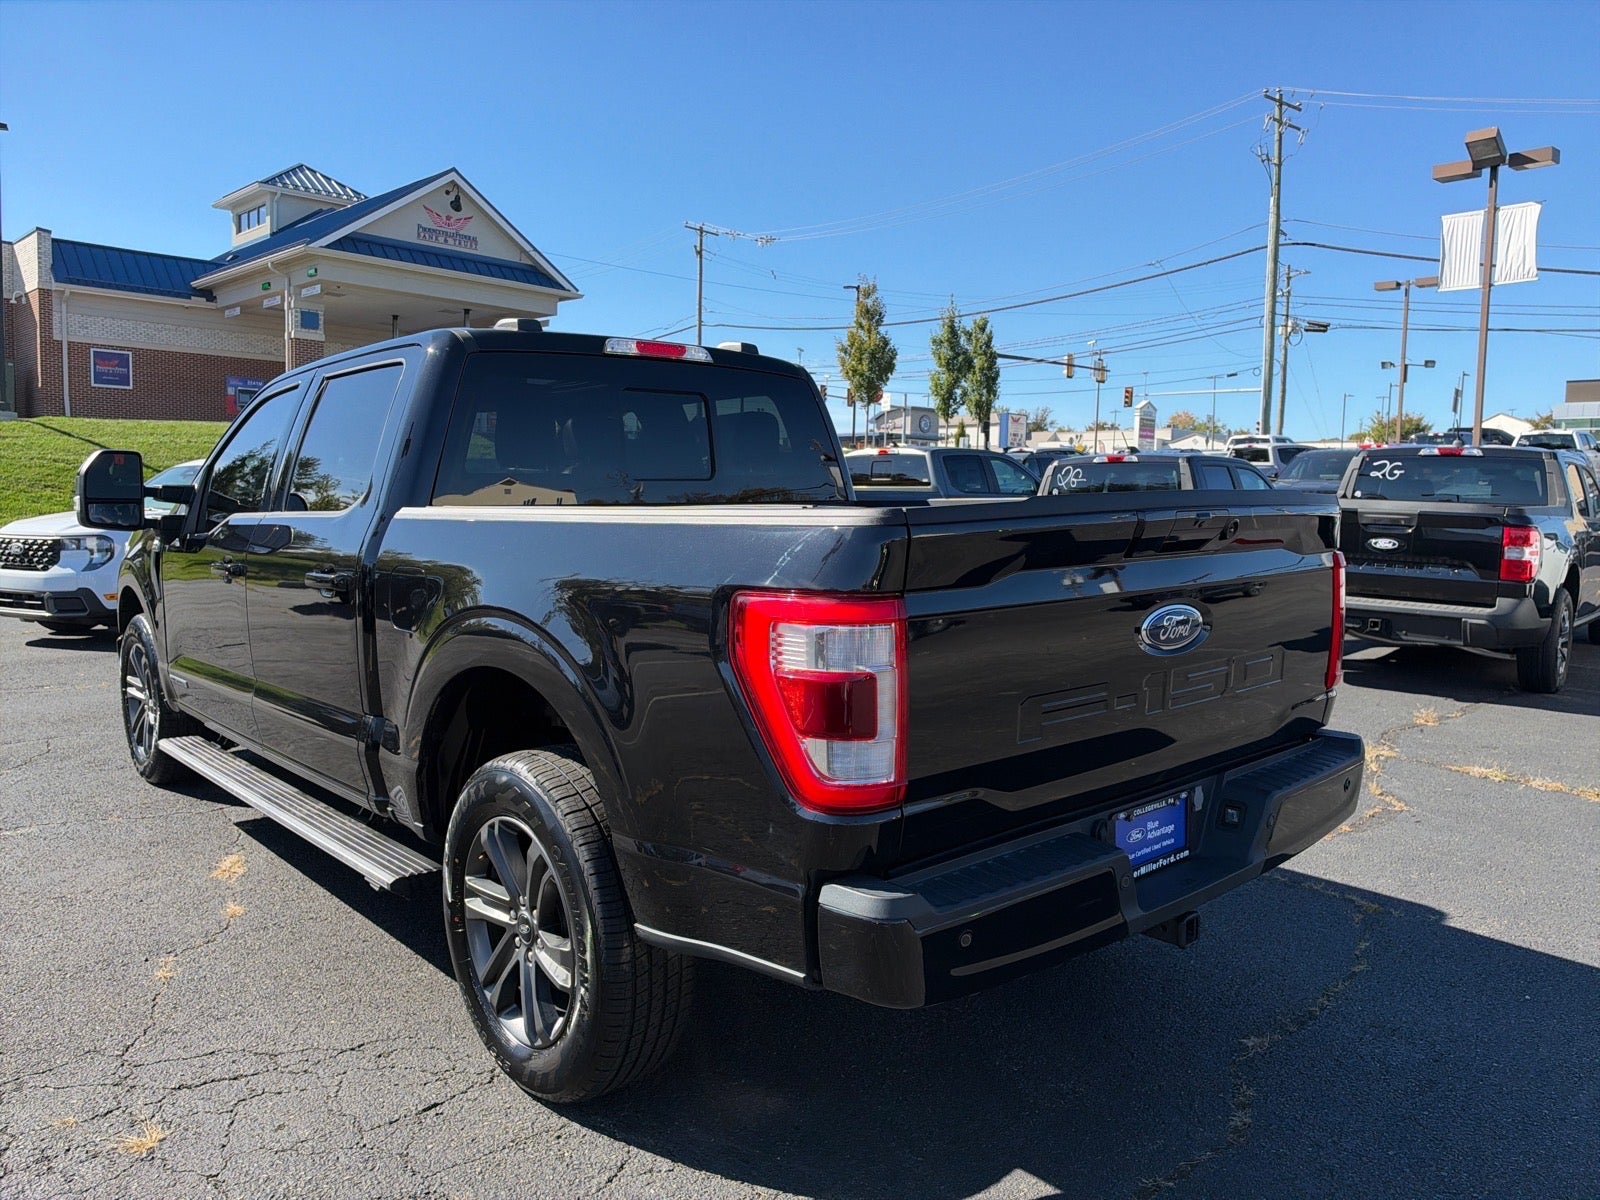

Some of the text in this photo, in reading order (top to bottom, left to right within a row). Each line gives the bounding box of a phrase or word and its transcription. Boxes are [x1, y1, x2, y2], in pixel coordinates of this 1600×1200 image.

[1160, 615, 1192, 640] Ford
[1017, 646, 1284, 744] F-150
[1129, 829, 1143, 841] Ford
[1147, 820, 1159, 830] Blue
[1147, 824, 1175, 839] Advantage
[1133, 850, 1189, 878] erMillerFord.com
